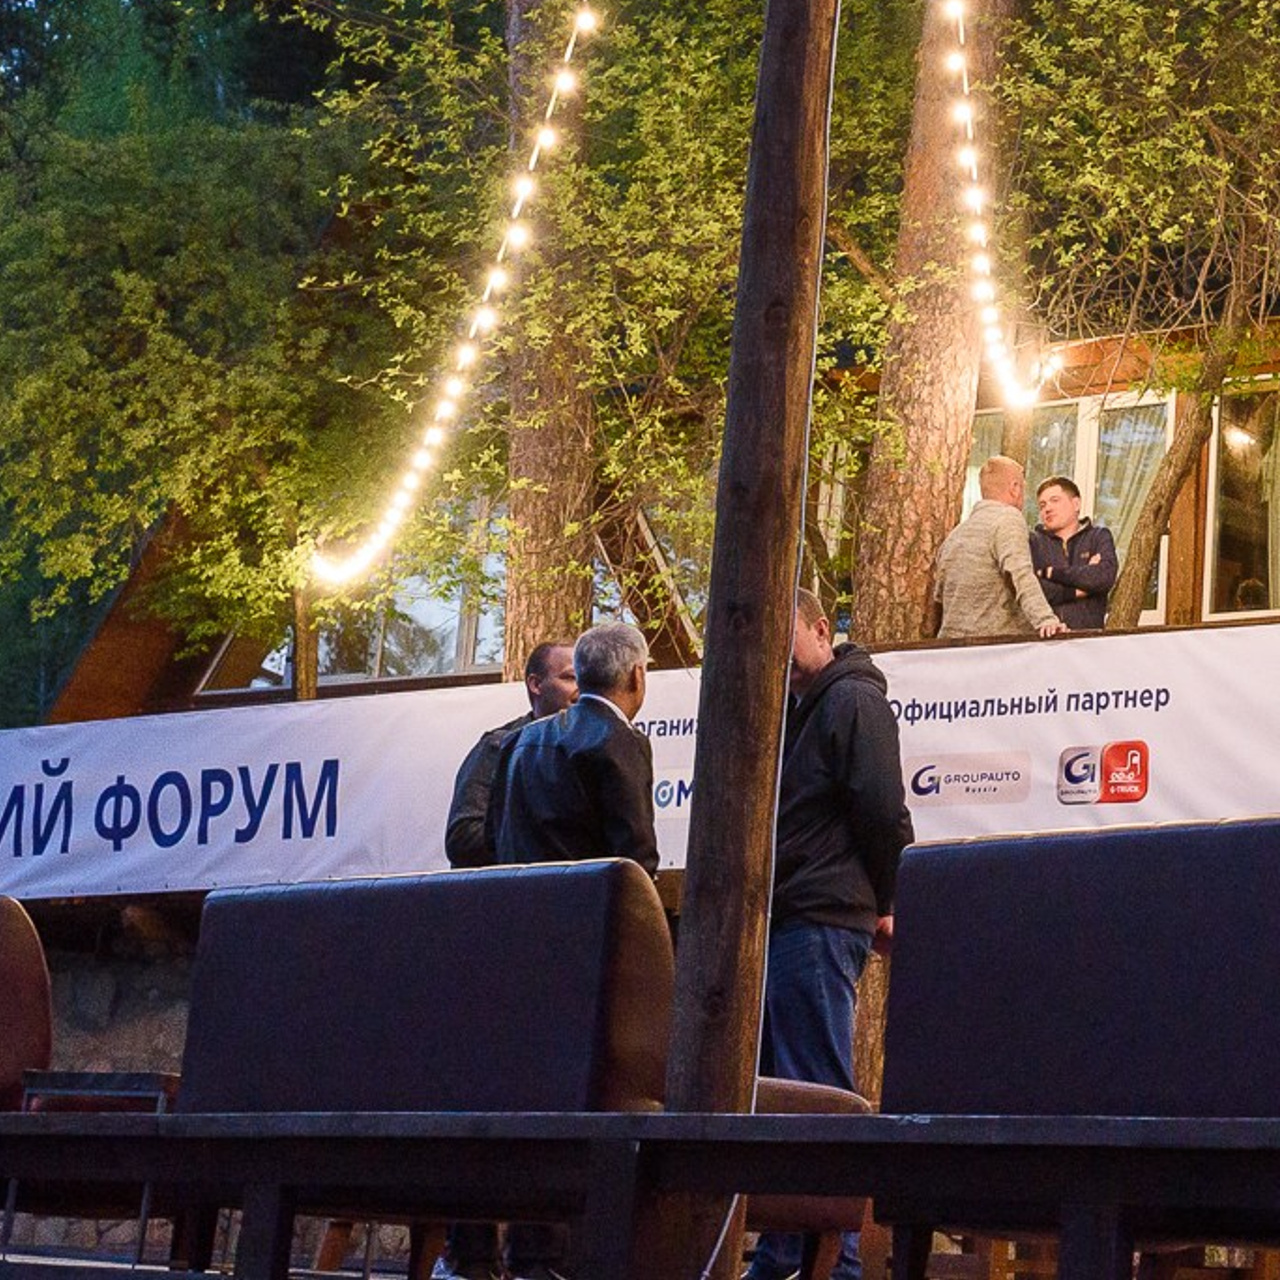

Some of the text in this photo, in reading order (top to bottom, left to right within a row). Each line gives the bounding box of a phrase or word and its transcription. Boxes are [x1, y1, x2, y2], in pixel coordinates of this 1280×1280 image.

[1066, 687, 1170, 715] партнер
[944, 771, 1021, 785] GROUPAUTO
[94, 758, 339, 852] ФОРУМ
